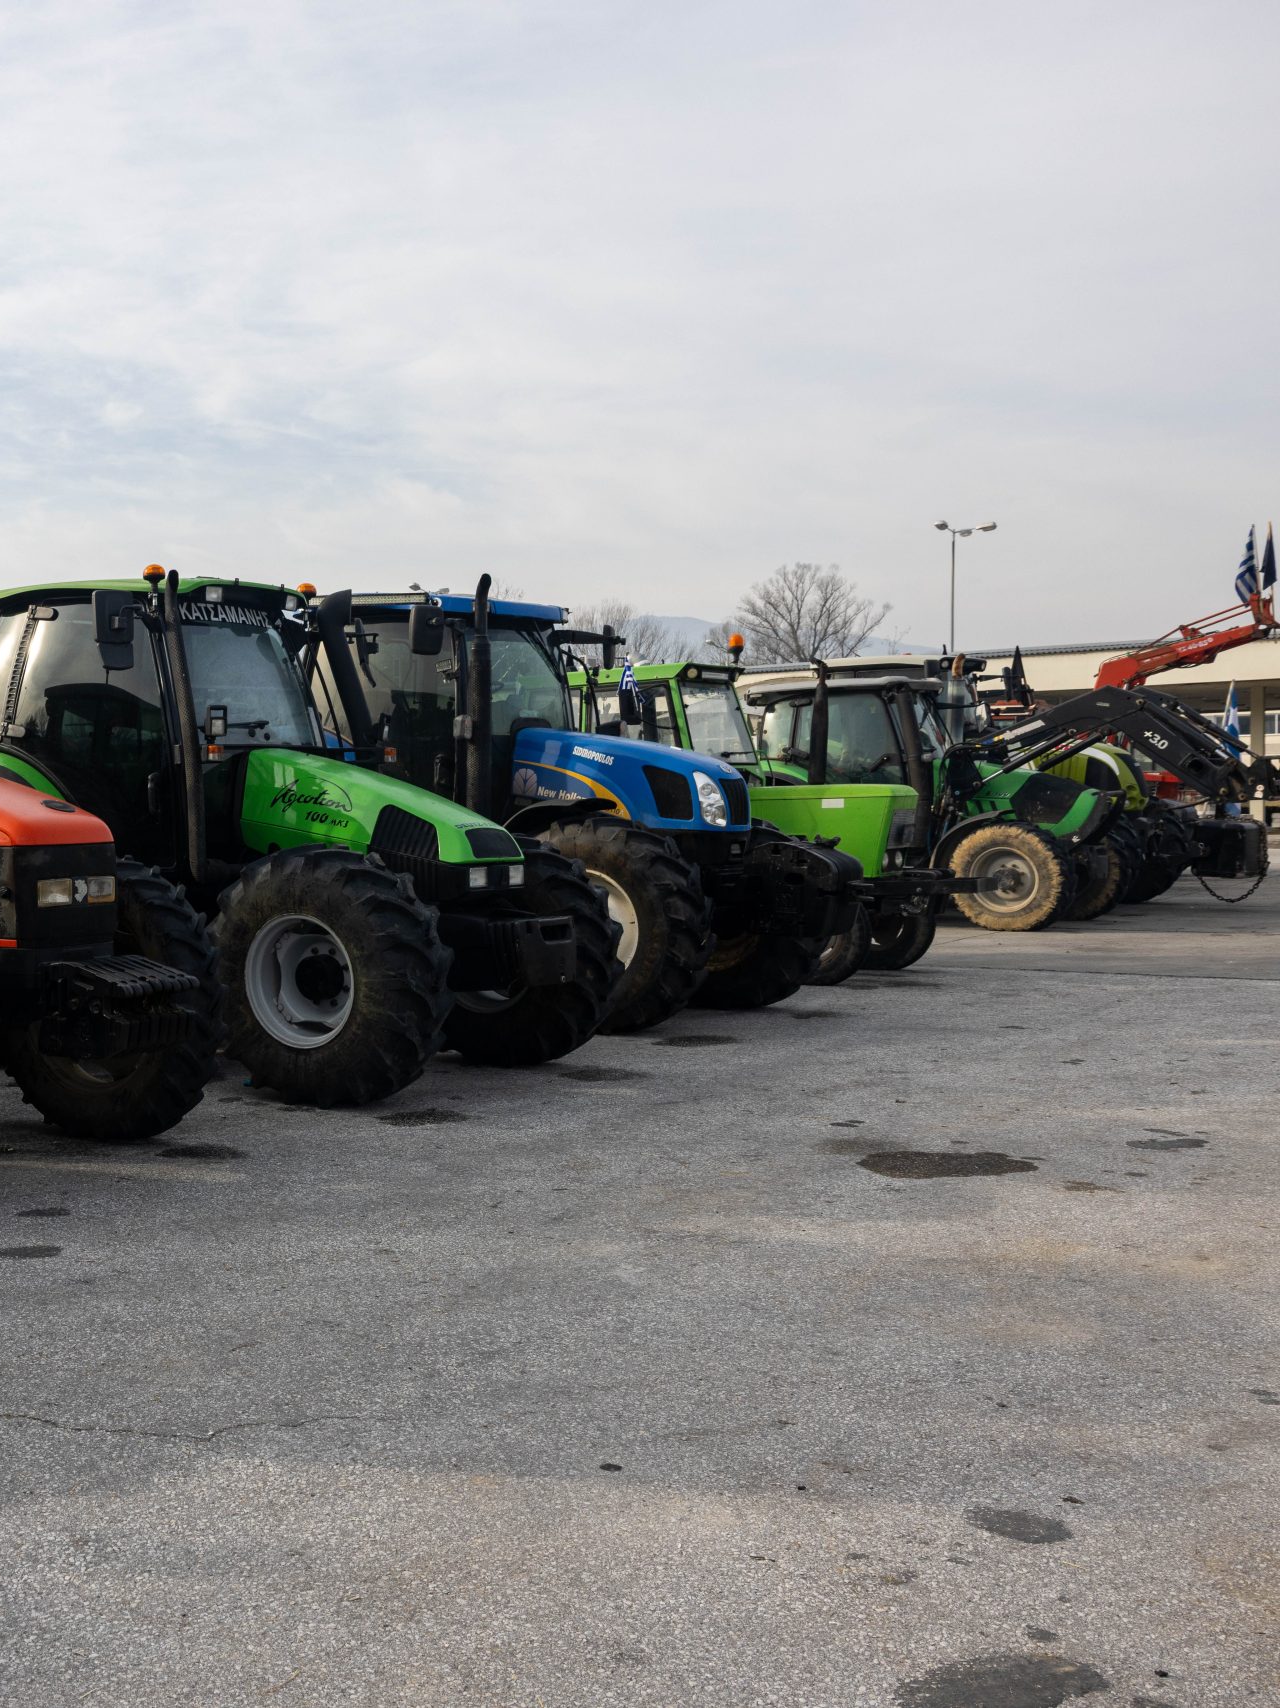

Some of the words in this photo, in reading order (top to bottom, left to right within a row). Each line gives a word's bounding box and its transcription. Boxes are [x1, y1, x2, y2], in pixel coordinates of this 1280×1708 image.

[179, 602, 272, 628] ΚΑΤΣΑΜΑΝΗΣ
[537, 786, 556, 797] New
[304, 811, 329, 823] 100
